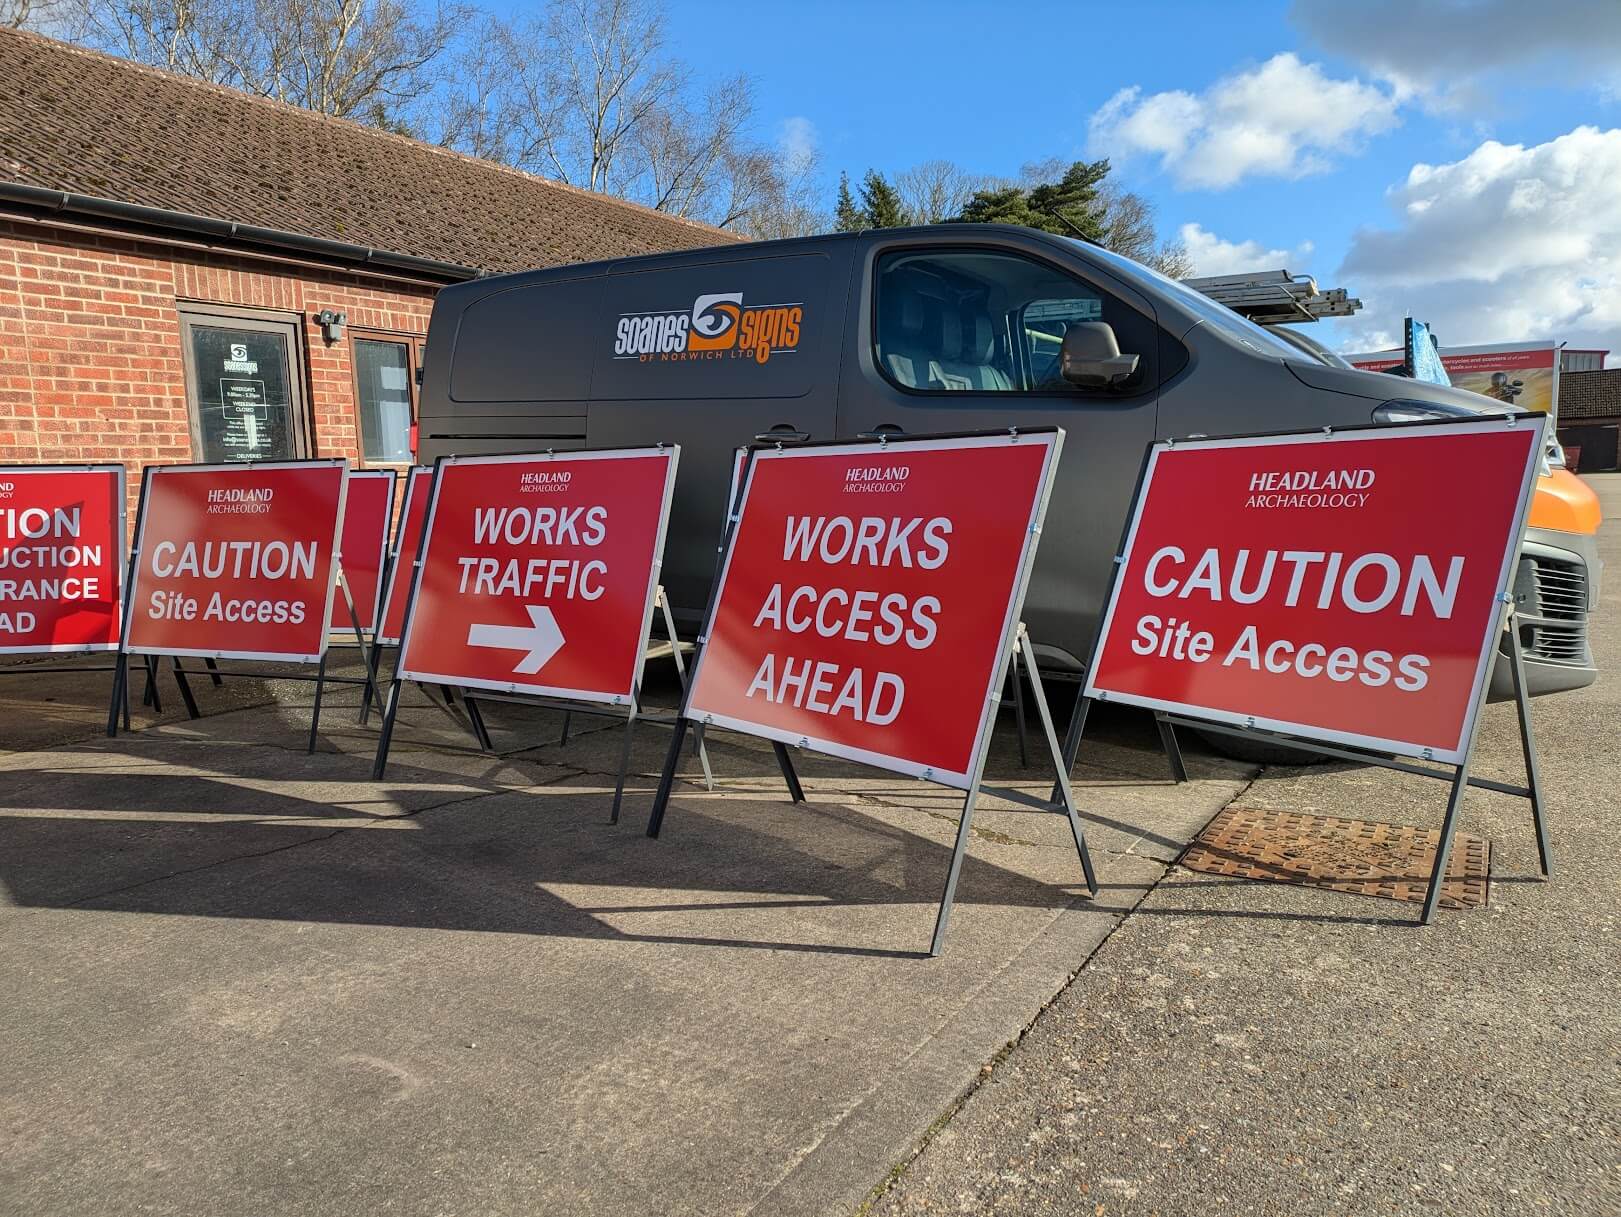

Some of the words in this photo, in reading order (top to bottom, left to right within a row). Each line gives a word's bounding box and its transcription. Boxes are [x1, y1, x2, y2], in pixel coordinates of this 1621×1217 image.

[614, 314, 689, 355] soanes
[738, 307, 802, 365] signs
[639, 353, 655, 363] OF
[661, 350, 724, 362] NORWICH
[730, 350, 754, 360] LTD
[519, 483, 570, 493] ARCHAEOLOGY
[520, 471, 572, 484] HEADLAND
[842, 481, 906, 493] ARCHAEOLOGY
[845, 466, 910, 482] HEADLAND
[1248, 469, 1376, 492] HEADLAND
[207, 488, 274, 502] HEADLAND
[207, 502, 272, 514] ARCHAEOLOGY
[1244, 492, 1370, 509] ARCHAEOLOGY
[474, 505, 608, 546] WORKS
[783, 515, 953, 570] WORKS
[151, 540, 318, 580] CAUTION
[0, 577, 99, 601] RANCE
[457, 557, 608, 601] TRAFFIC
[1143, 545, 1465, 620] CAUTION
[148, 590, 197, 621] Site
[203, 592, 306, 624] Access
[753, 583, 942, 650] ACCESS
[1131, 614, 1214, 664] Site
[1223, 625, 1431, 692] Access
[745, 653, 905, 726] AHEAD
